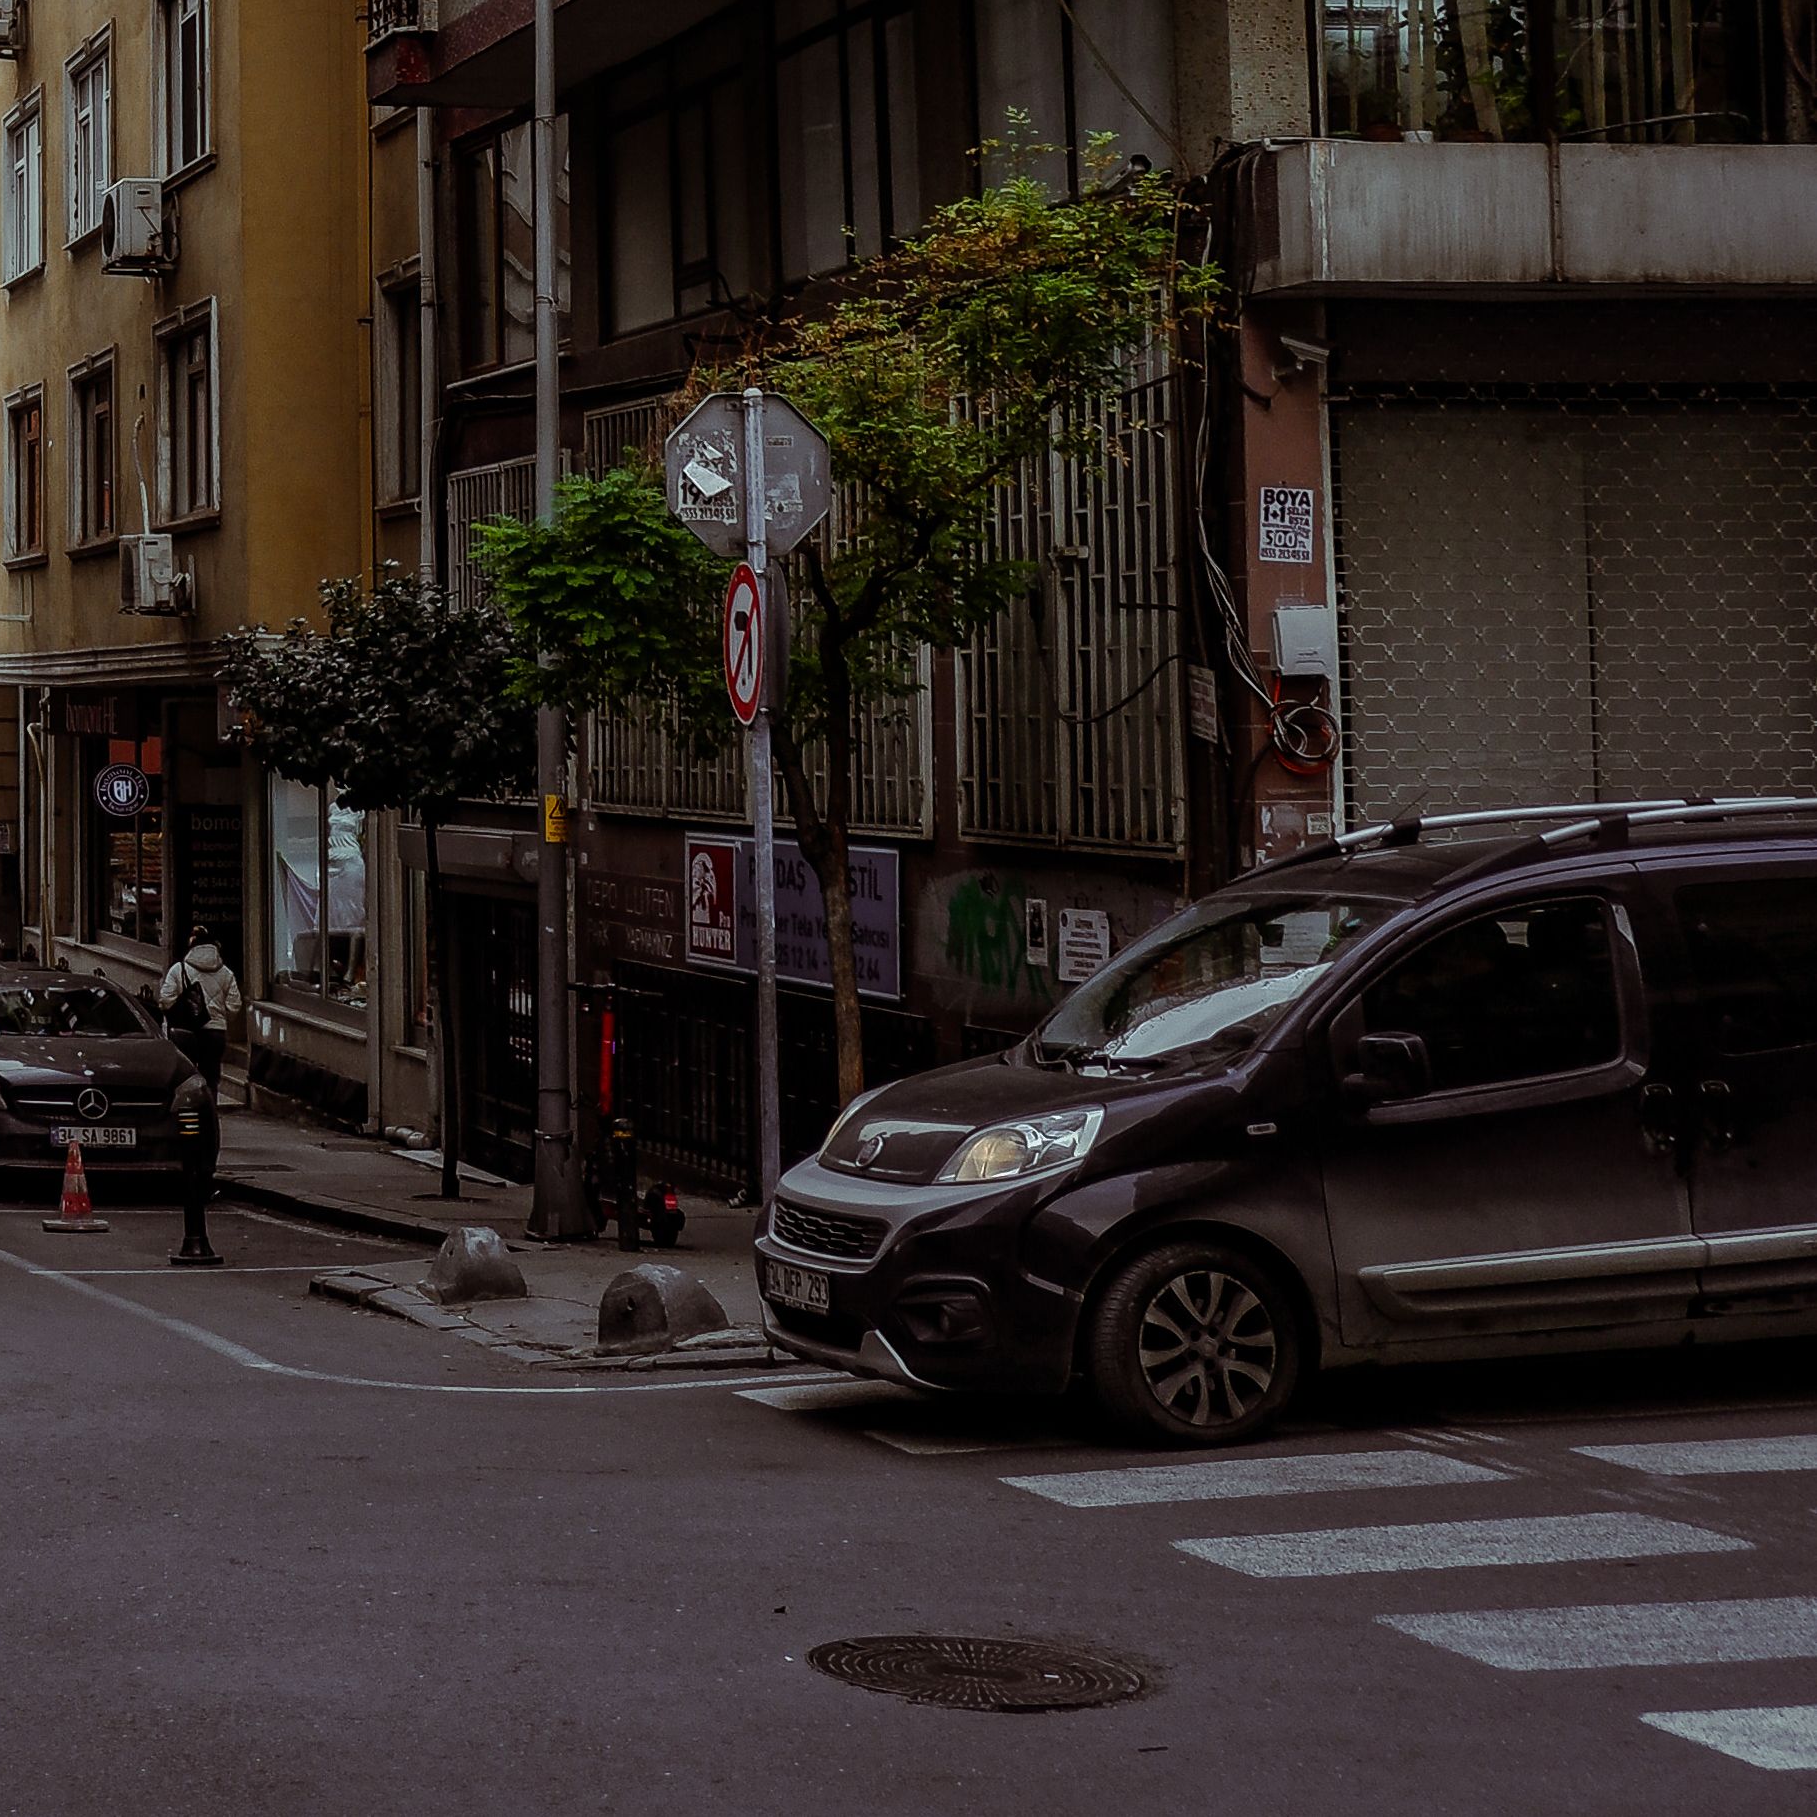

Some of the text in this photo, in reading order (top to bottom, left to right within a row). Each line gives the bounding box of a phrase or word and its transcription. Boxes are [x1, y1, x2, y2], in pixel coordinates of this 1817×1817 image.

[1263, 489, 1311, 507] BOYA
[1266, 530, 1297, 548] 500
[749, 856, 806, 896] PDAŞ
[692, 925, 731, 951] HUNTER
[82, 1129, 98, 1143] SA
[103, 1129, 133, 1143] 9861
[808, 1273, 829, 1304] 293
